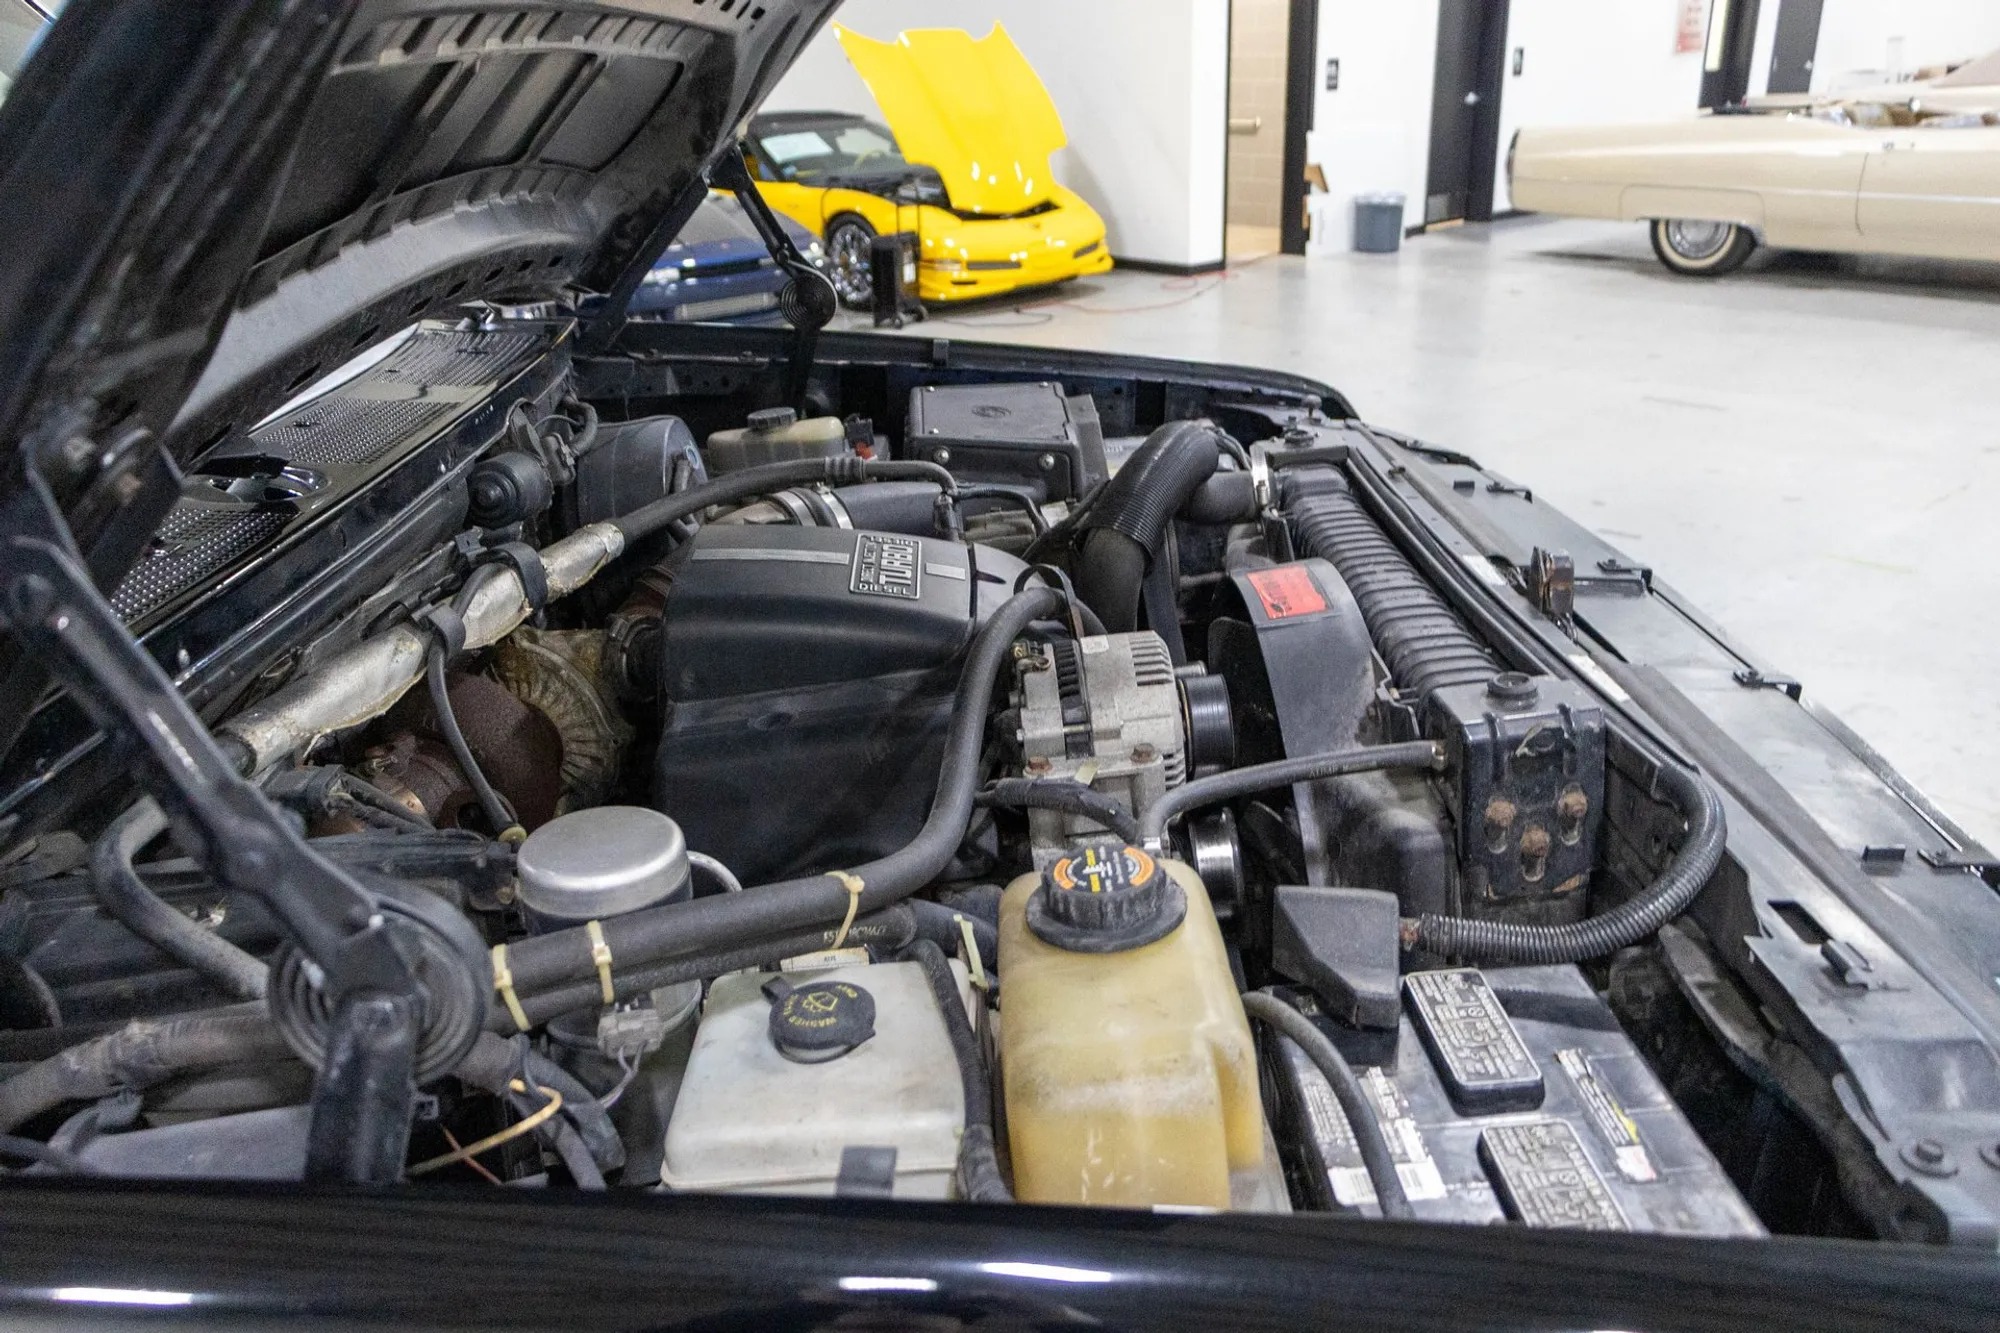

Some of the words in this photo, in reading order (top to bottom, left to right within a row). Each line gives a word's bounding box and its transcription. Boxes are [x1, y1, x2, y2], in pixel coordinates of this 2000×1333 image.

[879, 543, 913, 585] TURBO
[859, 583, 911, 595] DIESEL
[788, 1015, 837, 1028] WASHER
